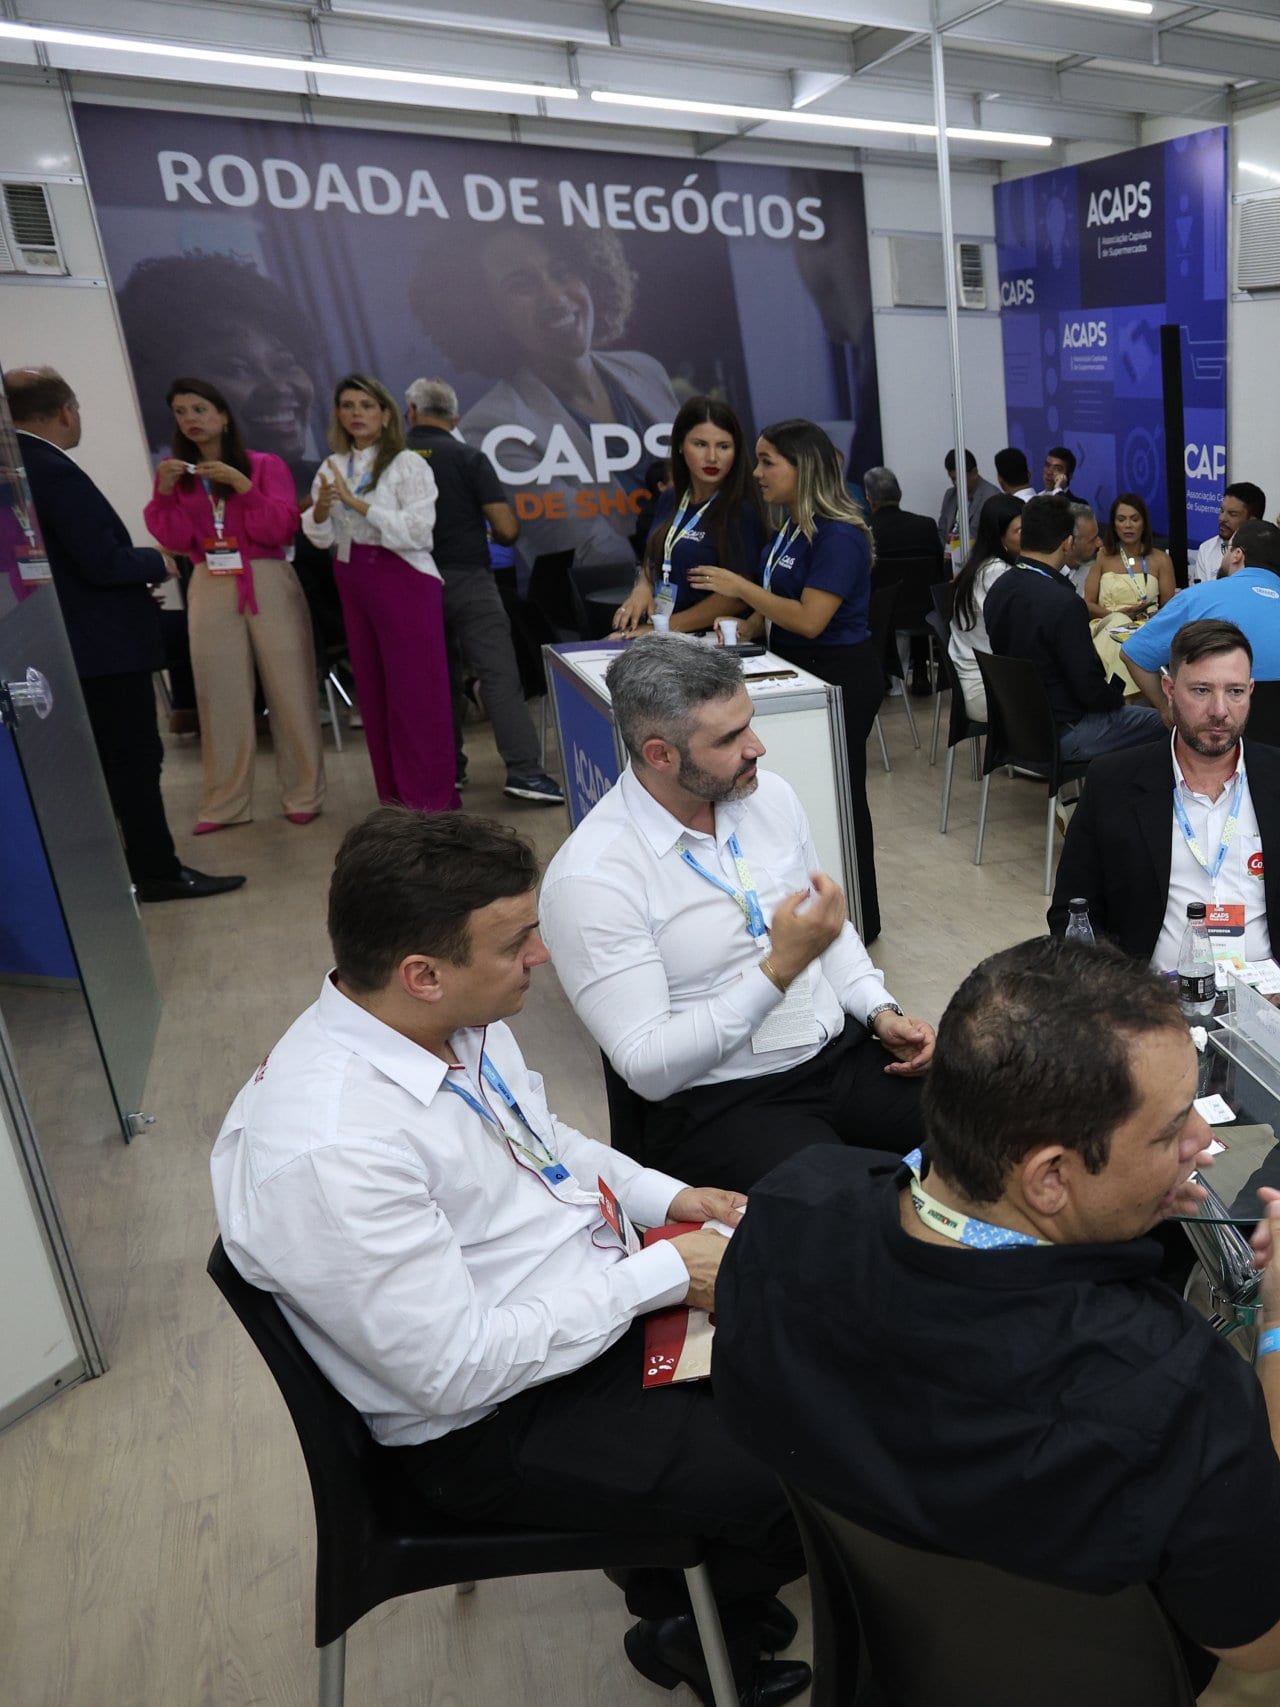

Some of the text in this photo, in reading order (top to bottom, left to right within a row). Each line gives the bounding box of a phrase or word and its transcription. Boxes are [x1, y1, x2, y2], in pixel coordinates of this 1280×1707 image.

[158, 150, 825, 240] RODADA DE NEGÓCIOS
[1087, 181, 1152, 228] ACAPS
[1001, 278, 1035, 307] CAPS
[1062, 321, 1107, 348] ACAPS
[450, 423, 674, 485] CAP
[1184, 443, 1226, 481] CAP
[515, 488, 653, 521] DE SHO
